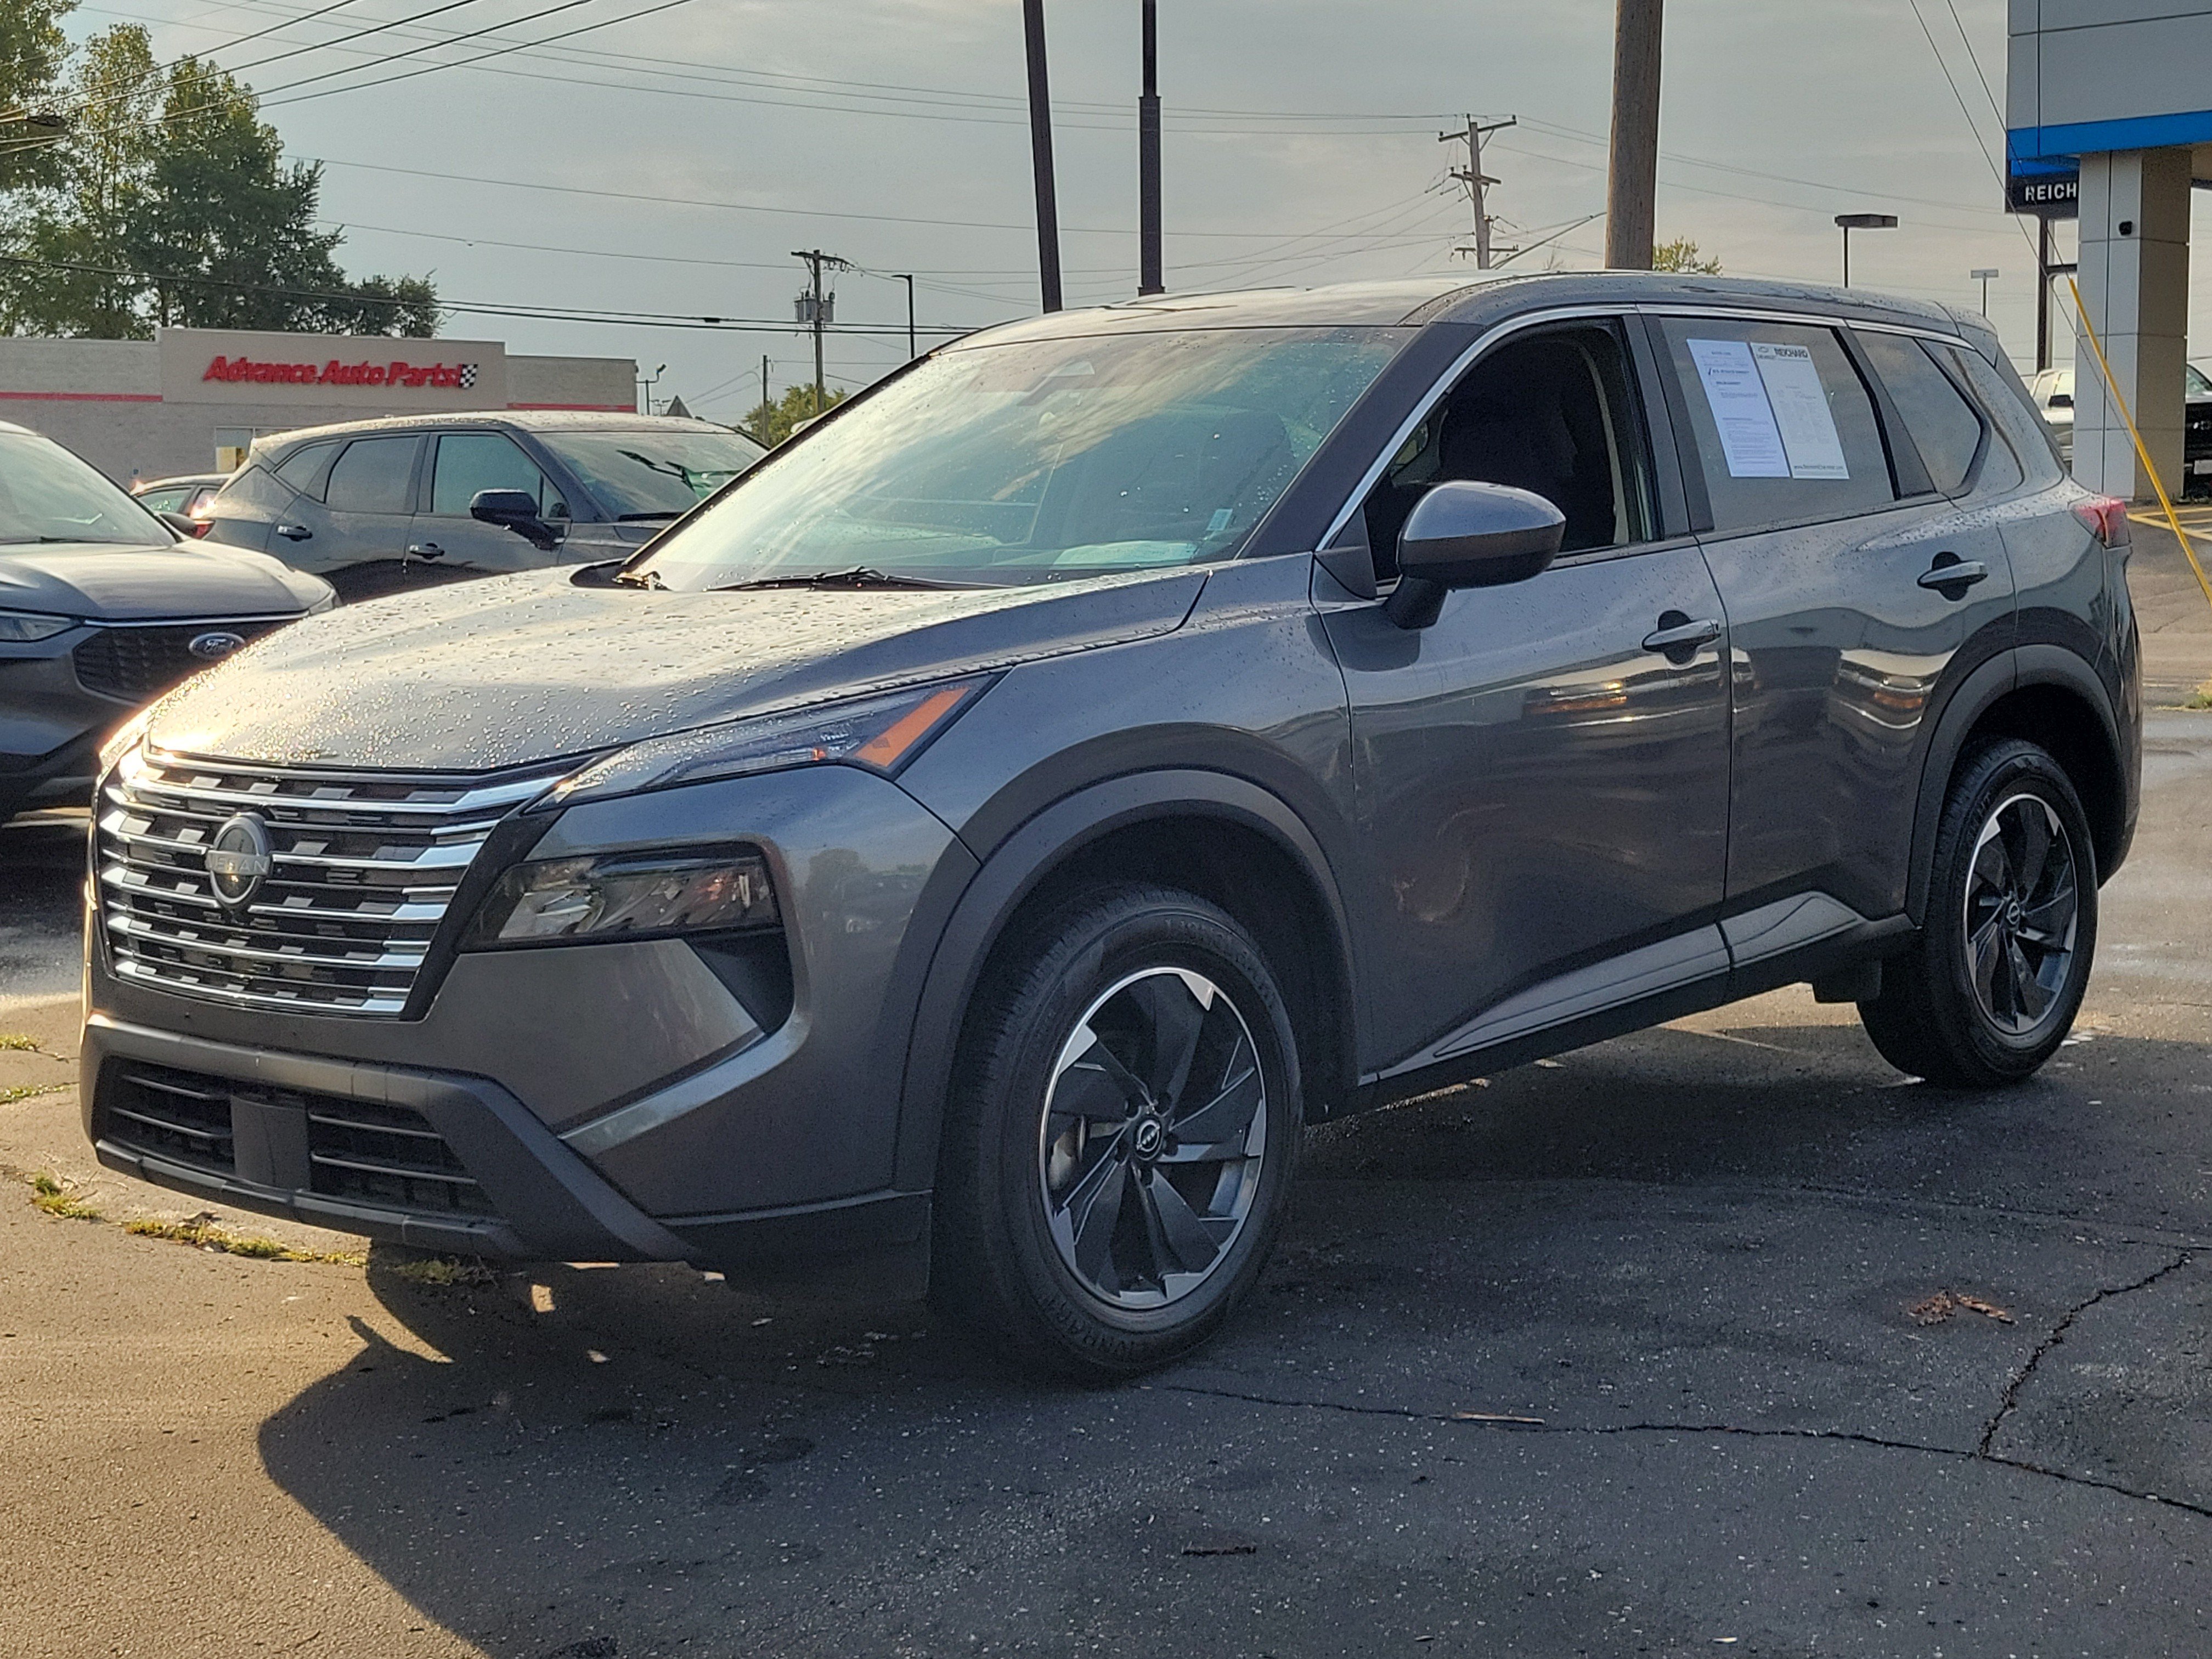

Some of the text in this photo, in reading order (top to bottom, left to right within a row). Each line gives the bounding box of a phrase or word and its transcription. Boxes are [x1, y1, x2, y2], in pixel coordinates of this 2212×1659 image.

[2025, 183, 2076, 202] REICH
[204, 356, 460, 387] Advance Auto Parts
